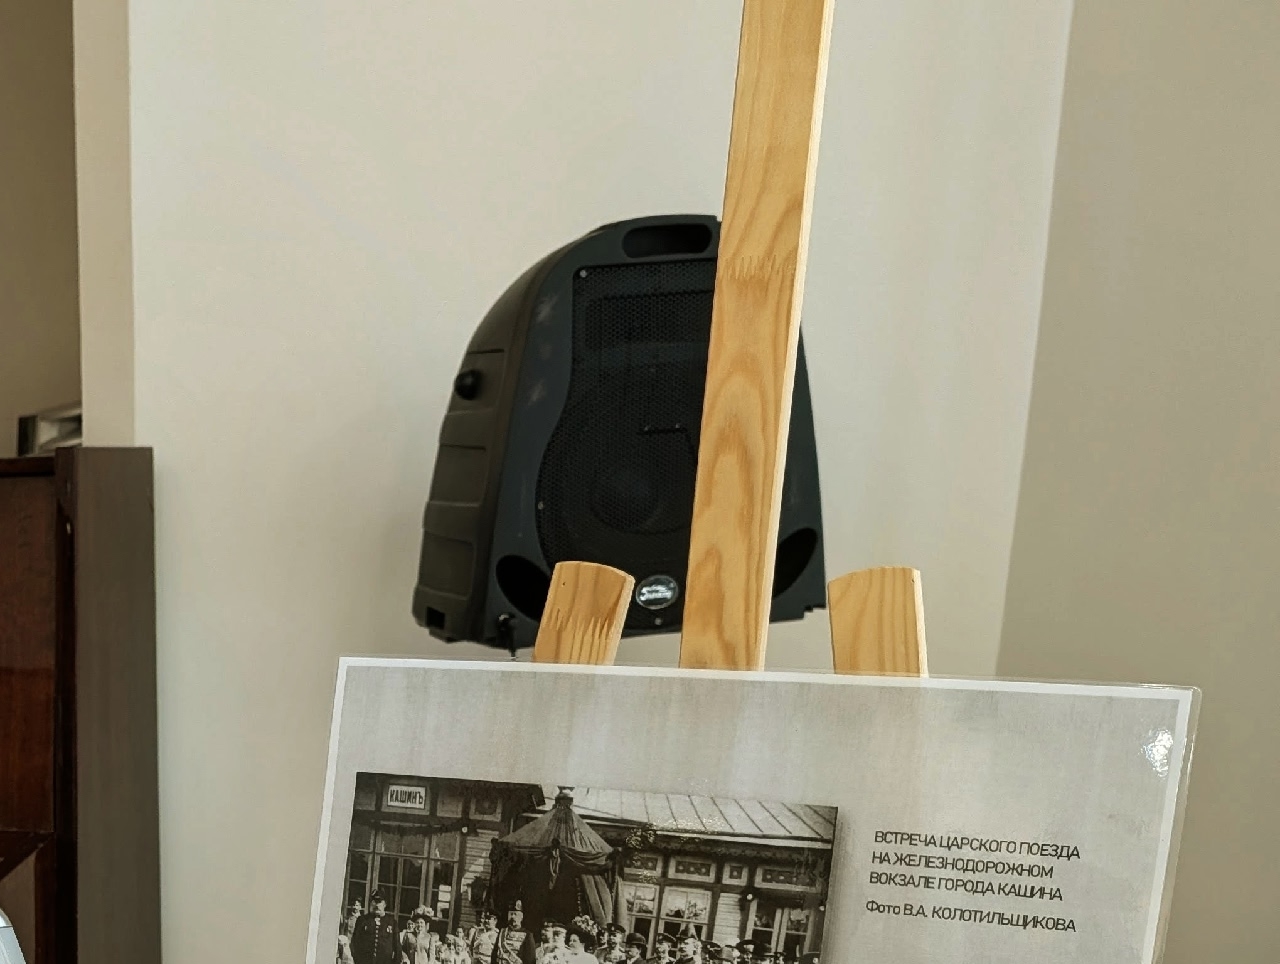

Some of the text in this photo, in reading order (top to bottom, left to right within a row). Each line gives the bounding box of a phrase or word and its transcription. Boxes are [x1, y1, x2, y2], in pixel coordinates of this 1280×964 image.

[389, 789, 424, 804] КАШИНЪ
[875, 831, 1080, 861] ВСТРЕЧА ЦАРСКОГО ПОЕЗДА
[872, 851, 1053, 878] НА ЖЕЛЕЗНОДОРОЖНОМ
[870, 871, 1063, 901] ВОКЗАЛЕ ГОРОДА КАШИНА
[866, 900, 1076, 932] Фото В.А. КОЛОТИЛЬЩИКОВА
